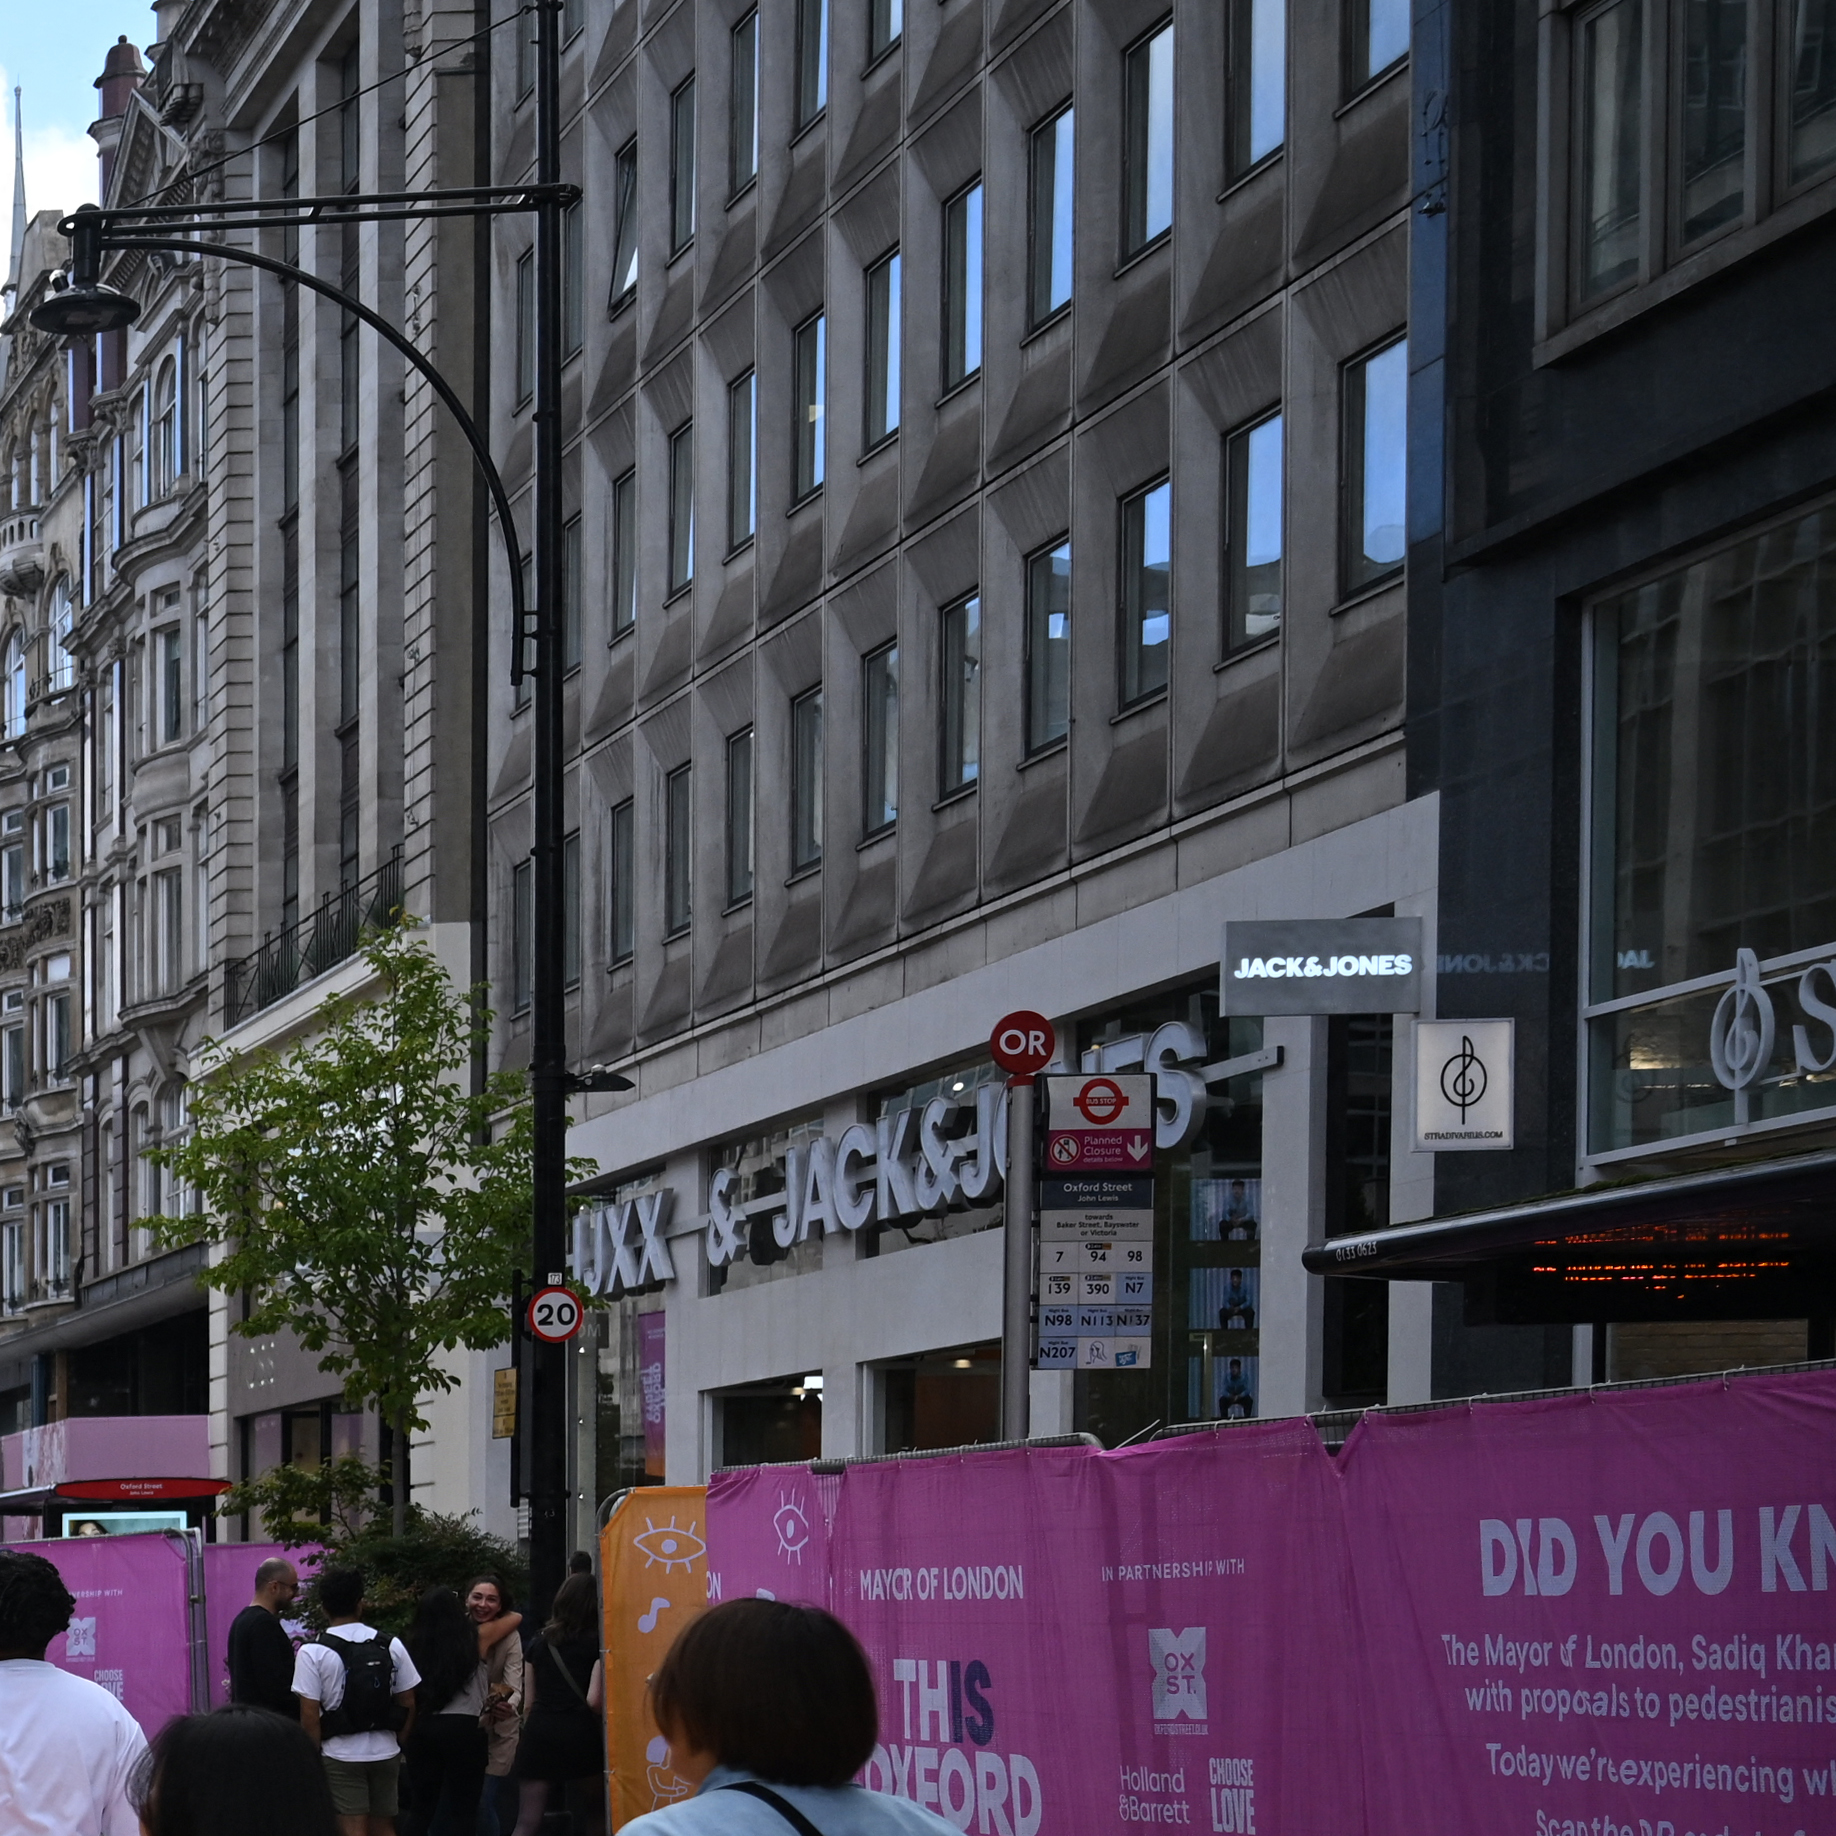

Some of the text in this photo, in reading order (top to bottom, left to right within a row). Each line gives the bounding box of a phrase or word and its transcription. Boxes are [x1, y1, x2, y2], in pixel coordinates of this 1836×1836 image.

[1234, 954, 1412, 979] JACK&JONES
[999, 1029, 1047, 1057] OR
[1084, 1136, 1122, 1145] Planned
[1424, 1131, 1503, 1141] STRADIVARIUS.COM
[1083, 1146, 1121, 1156] Closure
[1063, 1182, 1133, 1193] Oxford Street
[707, 1168, 746, 1267] &
[1104, 1222, 1140, 1230] Bayswater
[1056, 1251, 1064, 1262] 7
[1090, 1251, 1106, 1262] 94
[1127, 1250, 1143, 1262] 98
[1336, 1241, 1378, 1261] 0133 0623
[1048, 1282, 1071, 1294] 139
[1086, 1283, 1110, 1295] 390
[1125, 1282, 1144, 1294] N7
[537, 1303, 576, 1326] 20
[1045, 1314, 1073, 1326] N98
[1081, 1315, 1114, 1326] N113
[1116, 1314, 1151, 1326] N137
[1039, 1347, 1076, 1358] N207
[1480, 1517, 1577, 1596] DID
[1593, 1511, 1734, 1595] YOU
[1102, 1558, 1245, 1581] IN PARTNERSHIP WITH
[917, 1568, 939, 1599] OF
[943, 1565, 1024, 1600] LONDON
[73, 1627, 88, 1636] OX
[1164, 1653, 1195, 1672] OX
[1441, 1634, 1479, 1666] The
[1485, 1634, 1553, 1674] Mayor
[1560, 1635, 1577, 1667] of
[1585, 1635, 1684, 1676] London,
[1692, 1634, 1766, 1679] Sadiq
[94, 1670, 123, 1682] CHOOSE
[1166, 1675, 1197, 1694] ST.
[893, 1659, 994, 1746] THIS
[1465, 1680, 1512, 1711] with
[1521, 1684, 1630, 1721] proposals
[1634, 1687, 1660, 1718] to
[1120, 1766, 1185, 1793] Holland
[1209, 1757, 1254, 1787] CHOOSE
[1486, 1743, 1553, 1786] Today
[1619, 1754, 1794, 1803] experiencing
[1210, 1787, 1256, 1836] LOVE
